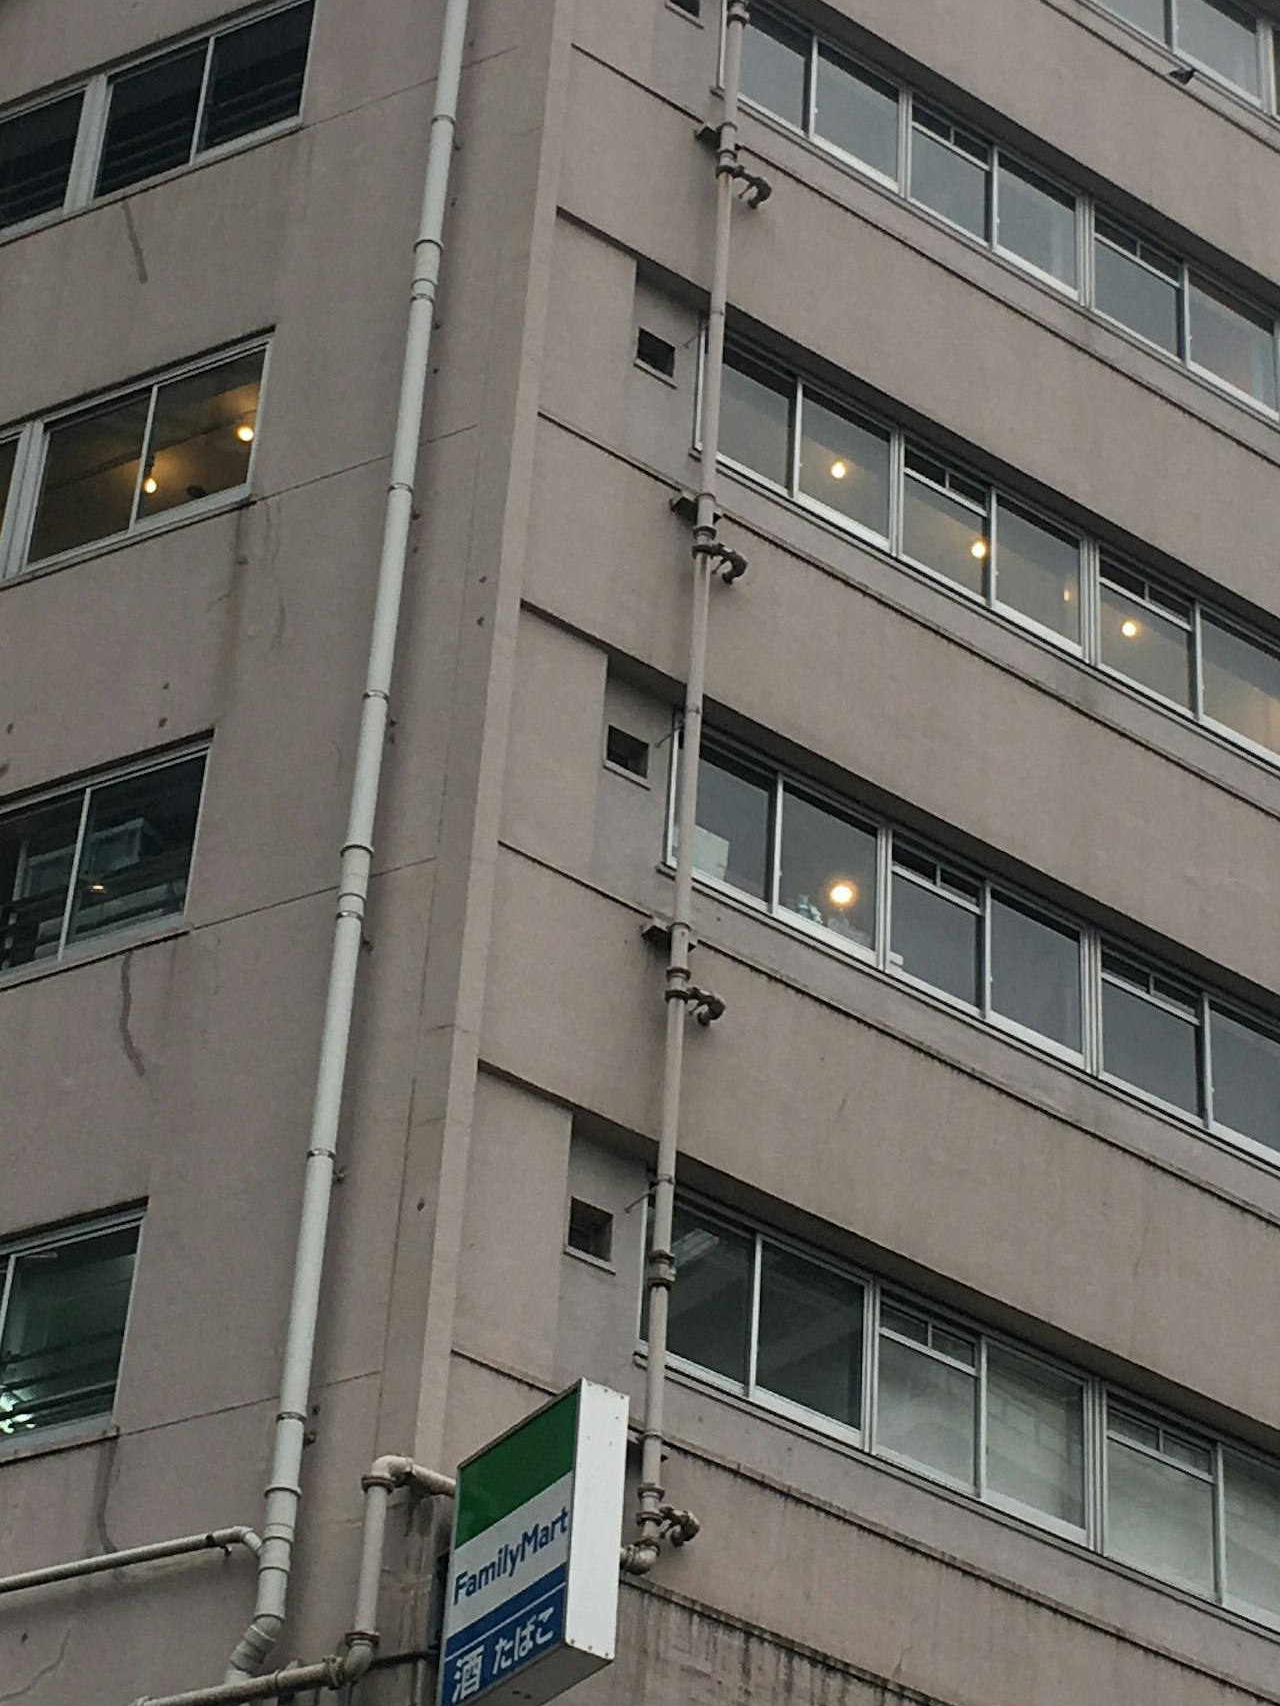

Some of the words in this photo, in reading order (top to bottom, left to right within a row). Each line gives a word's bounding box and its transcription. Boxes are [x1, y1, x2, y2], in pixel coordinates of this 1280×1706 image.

[454, 1507, 568, 1604] FamilyMart
[452, 1646, 483, 1703] 酒
[494, 1607, 555, 1675] たばこ
